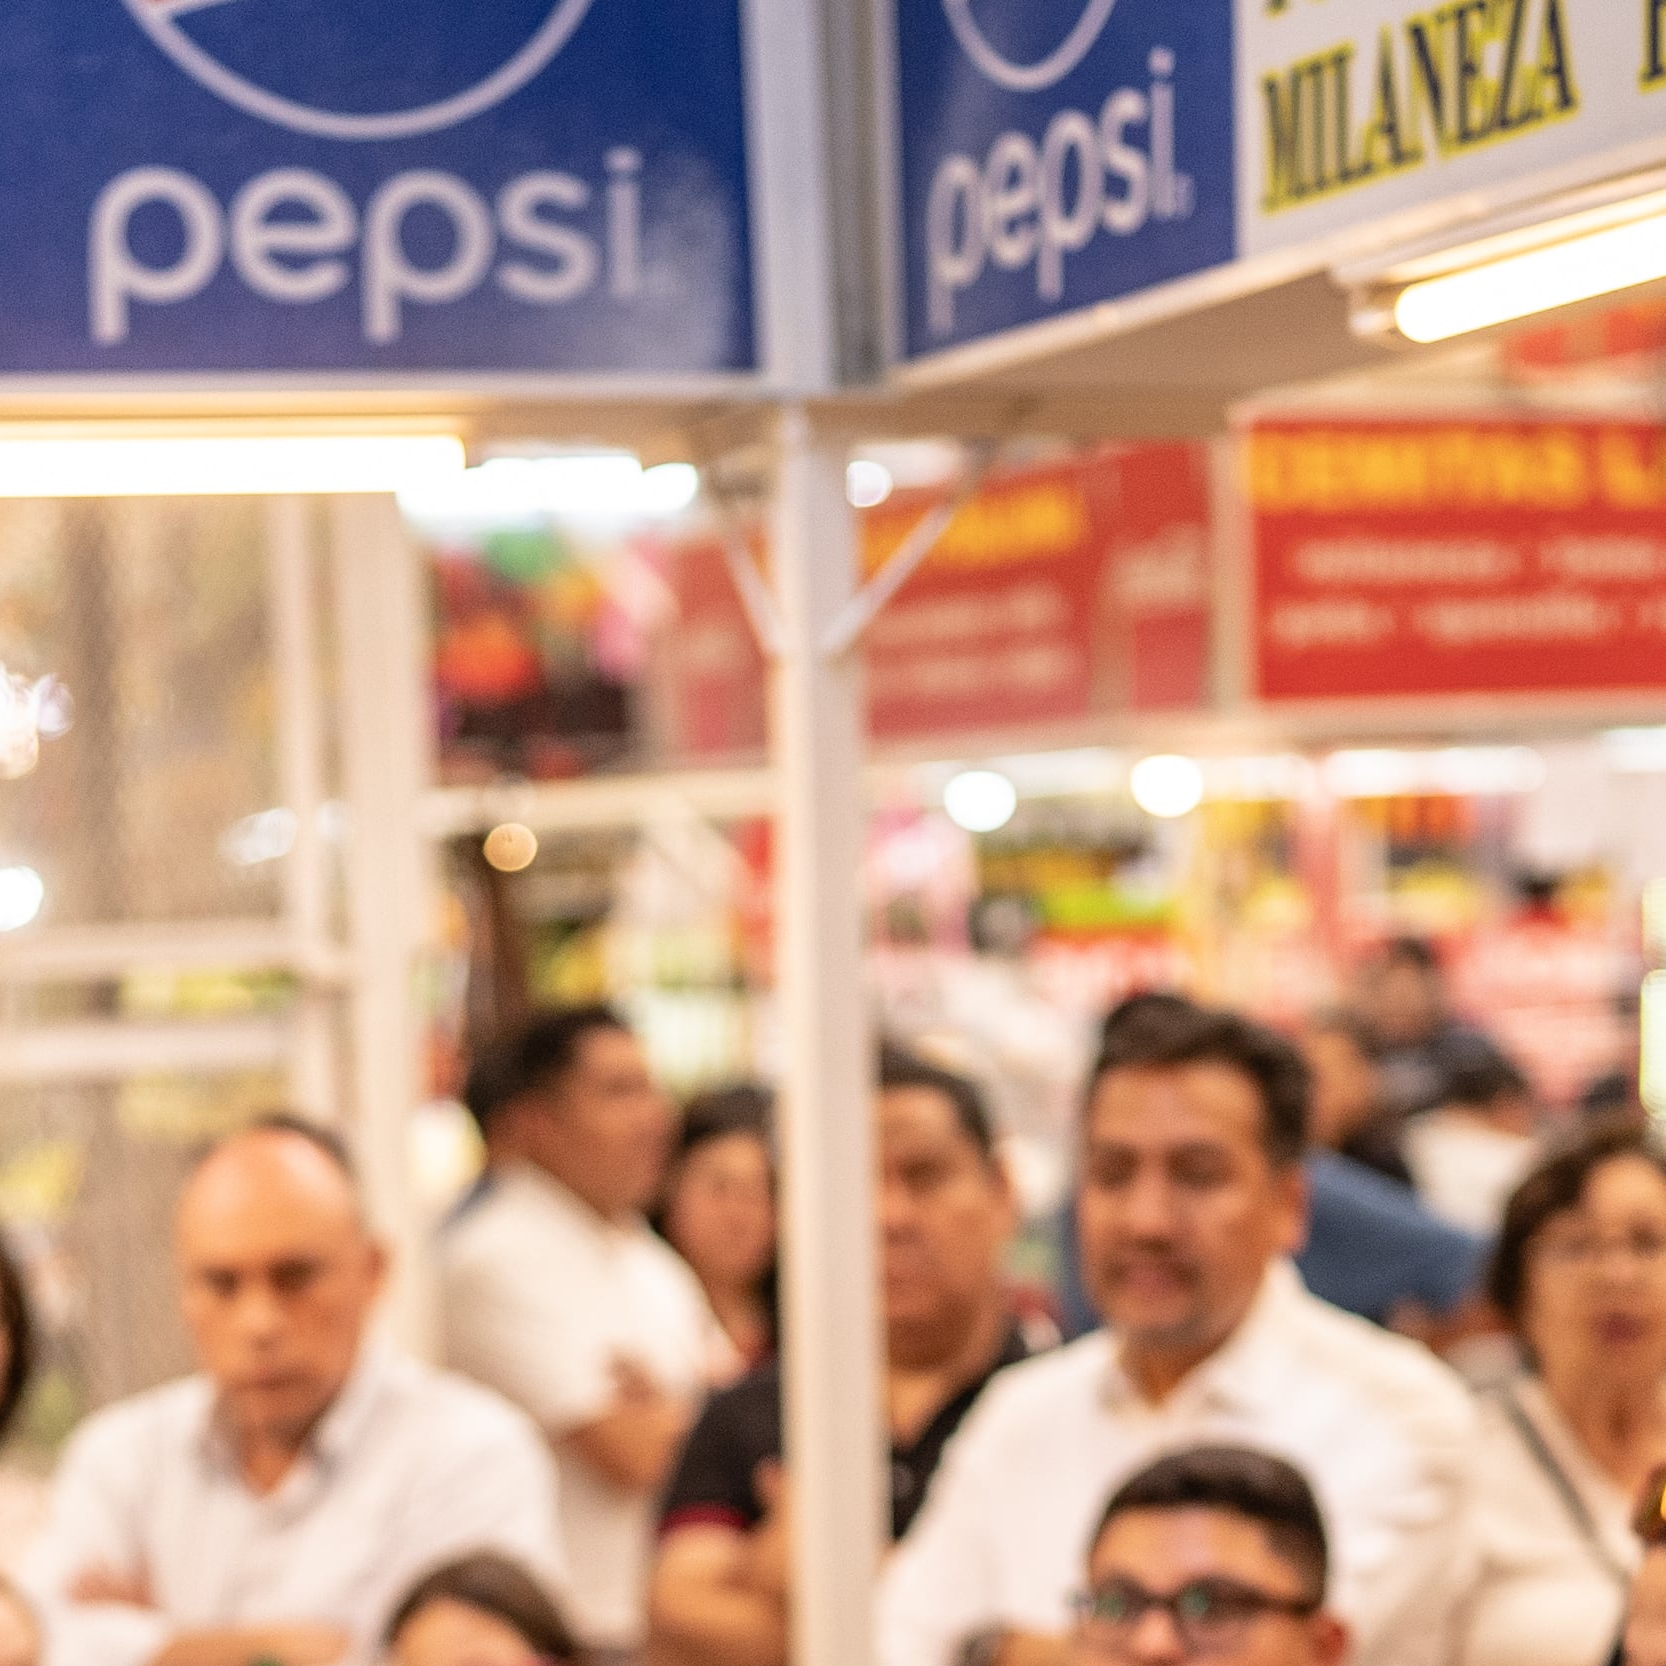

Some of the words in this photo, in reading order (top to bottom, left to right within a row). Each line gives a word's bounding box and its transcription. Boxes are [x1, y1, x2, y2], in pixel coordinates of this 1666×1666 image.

[925, 46, 1176, 340] pepsi
[1259, 0, 1581, 221] MILANEZA
[87, 144, 644, 347] pepsi
